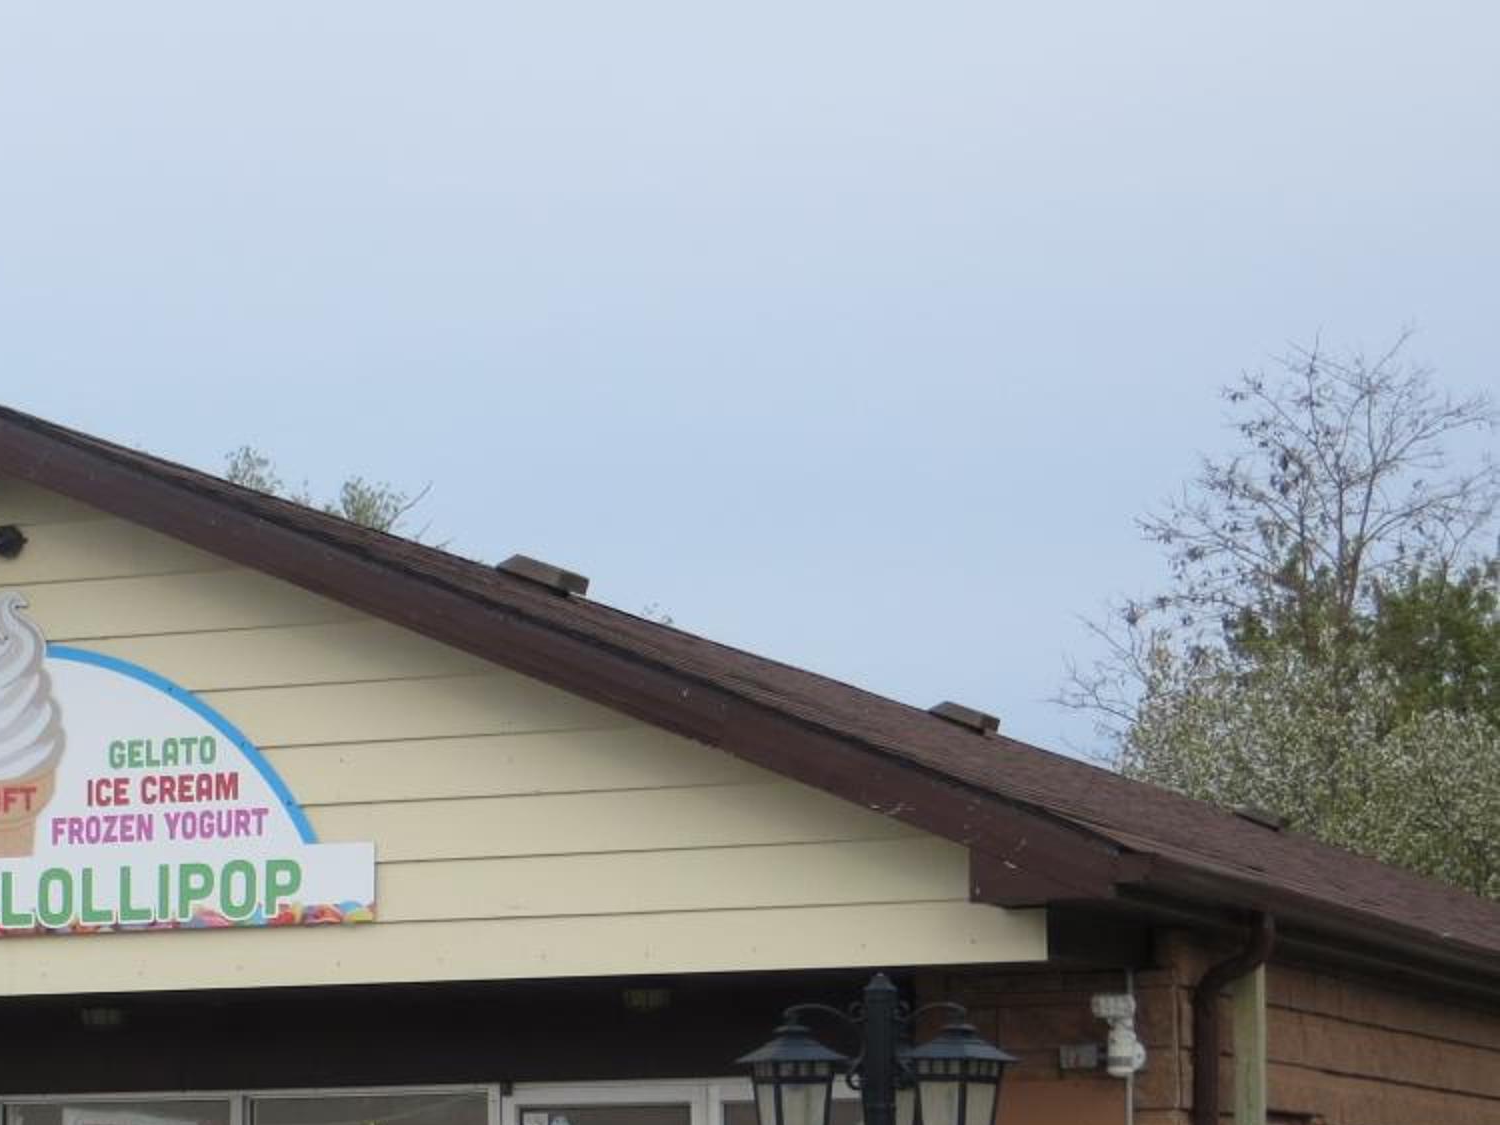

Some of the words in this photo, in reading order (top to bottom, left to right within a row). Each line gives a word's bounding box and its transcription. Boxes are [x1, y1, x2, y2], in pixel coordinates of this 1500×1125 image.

[108, 735, 217, 769] GELATO
[87, 778, 129, 808] ICE
[140, 771, 240, 804] CREAM
[52, 815, 155, 847] FROZEN
[164, 808, 270, 841] YOGURT
